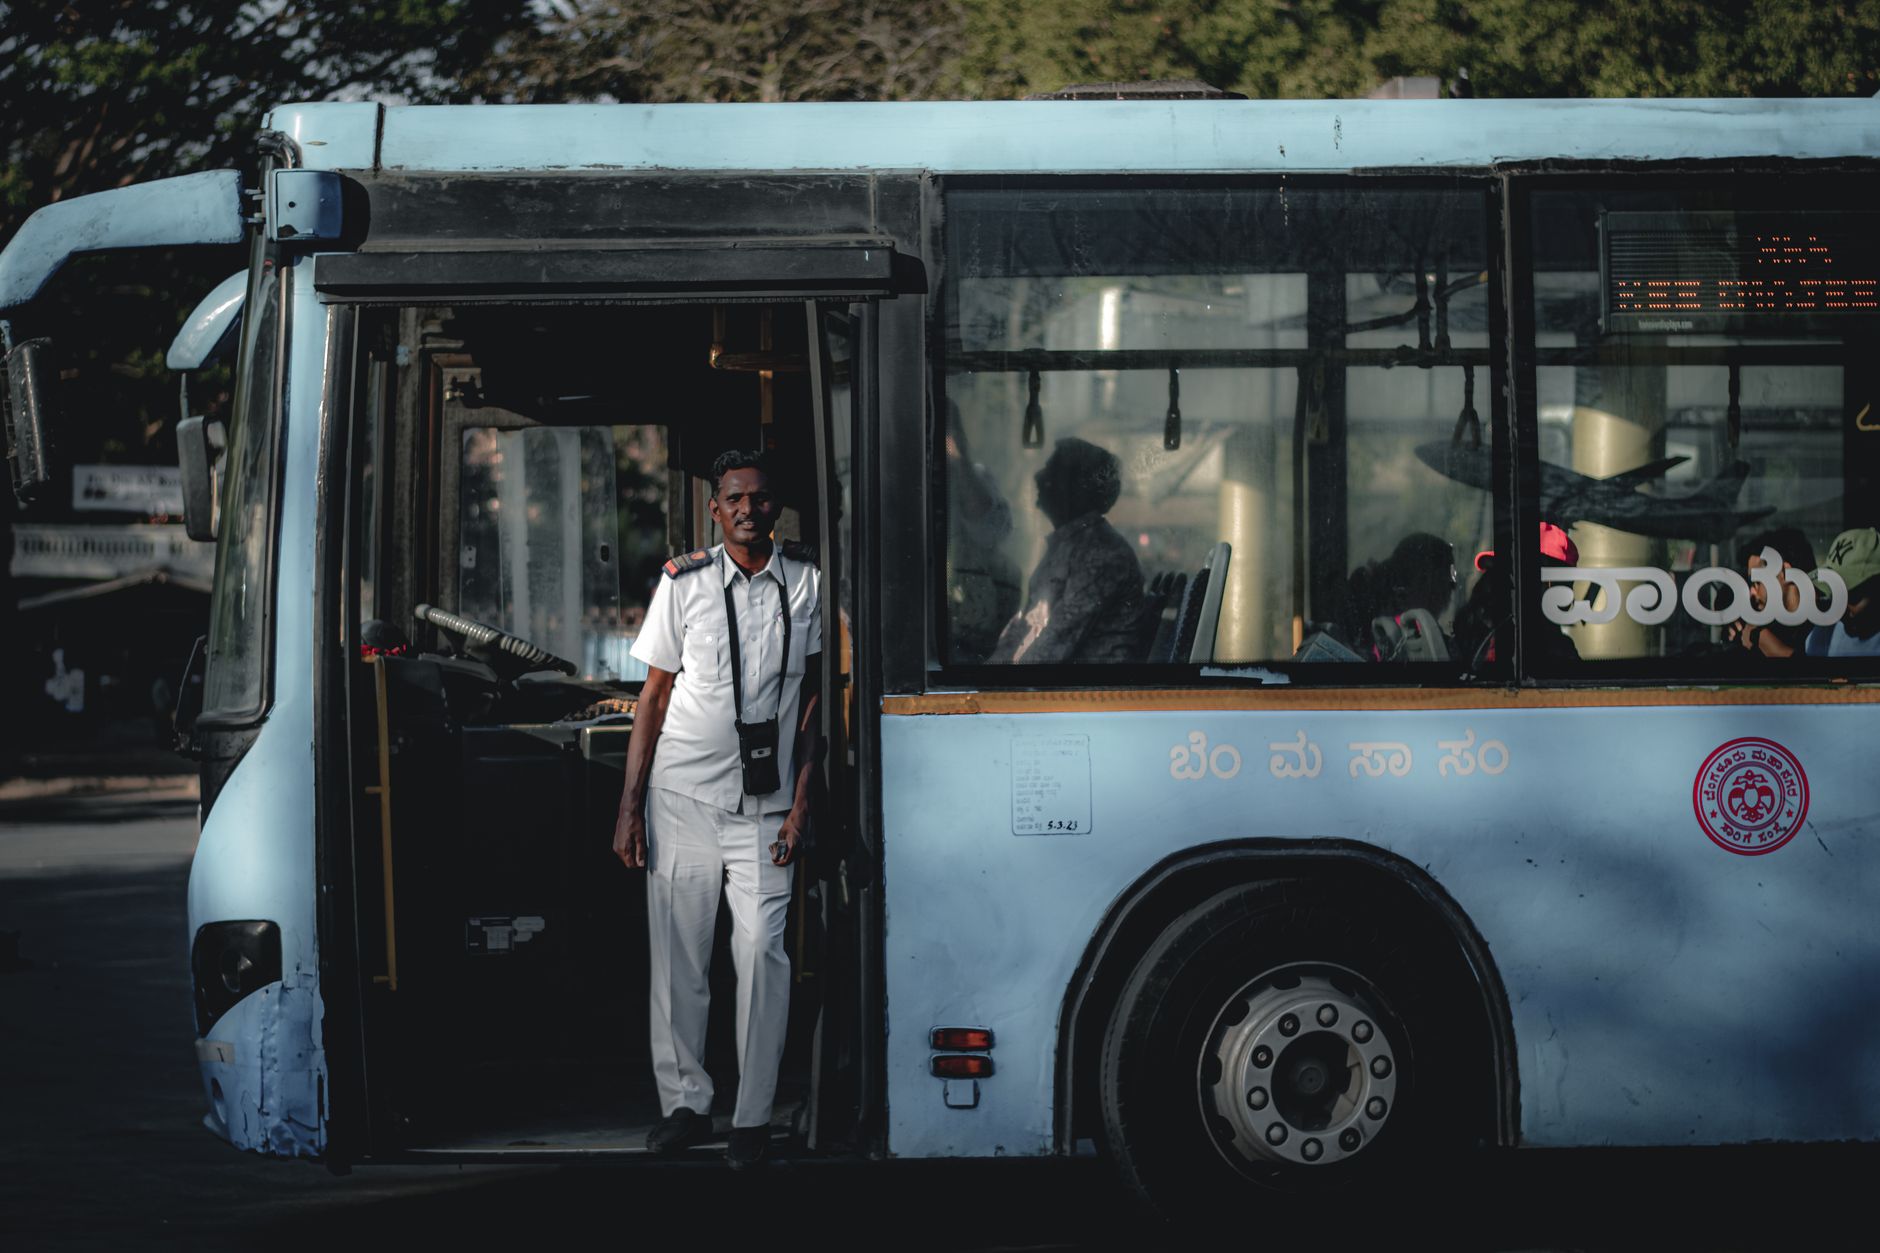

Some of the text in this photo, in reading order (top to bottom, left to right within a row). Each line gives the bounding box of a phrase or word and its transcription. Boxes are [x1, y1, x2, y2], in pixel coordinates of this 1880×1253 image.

[1540, 545, 1849, 626] ವಾಯು
[1168, 727, 1511, 780] ಬೆಂ ಮ ಸಾ ಸಂ
